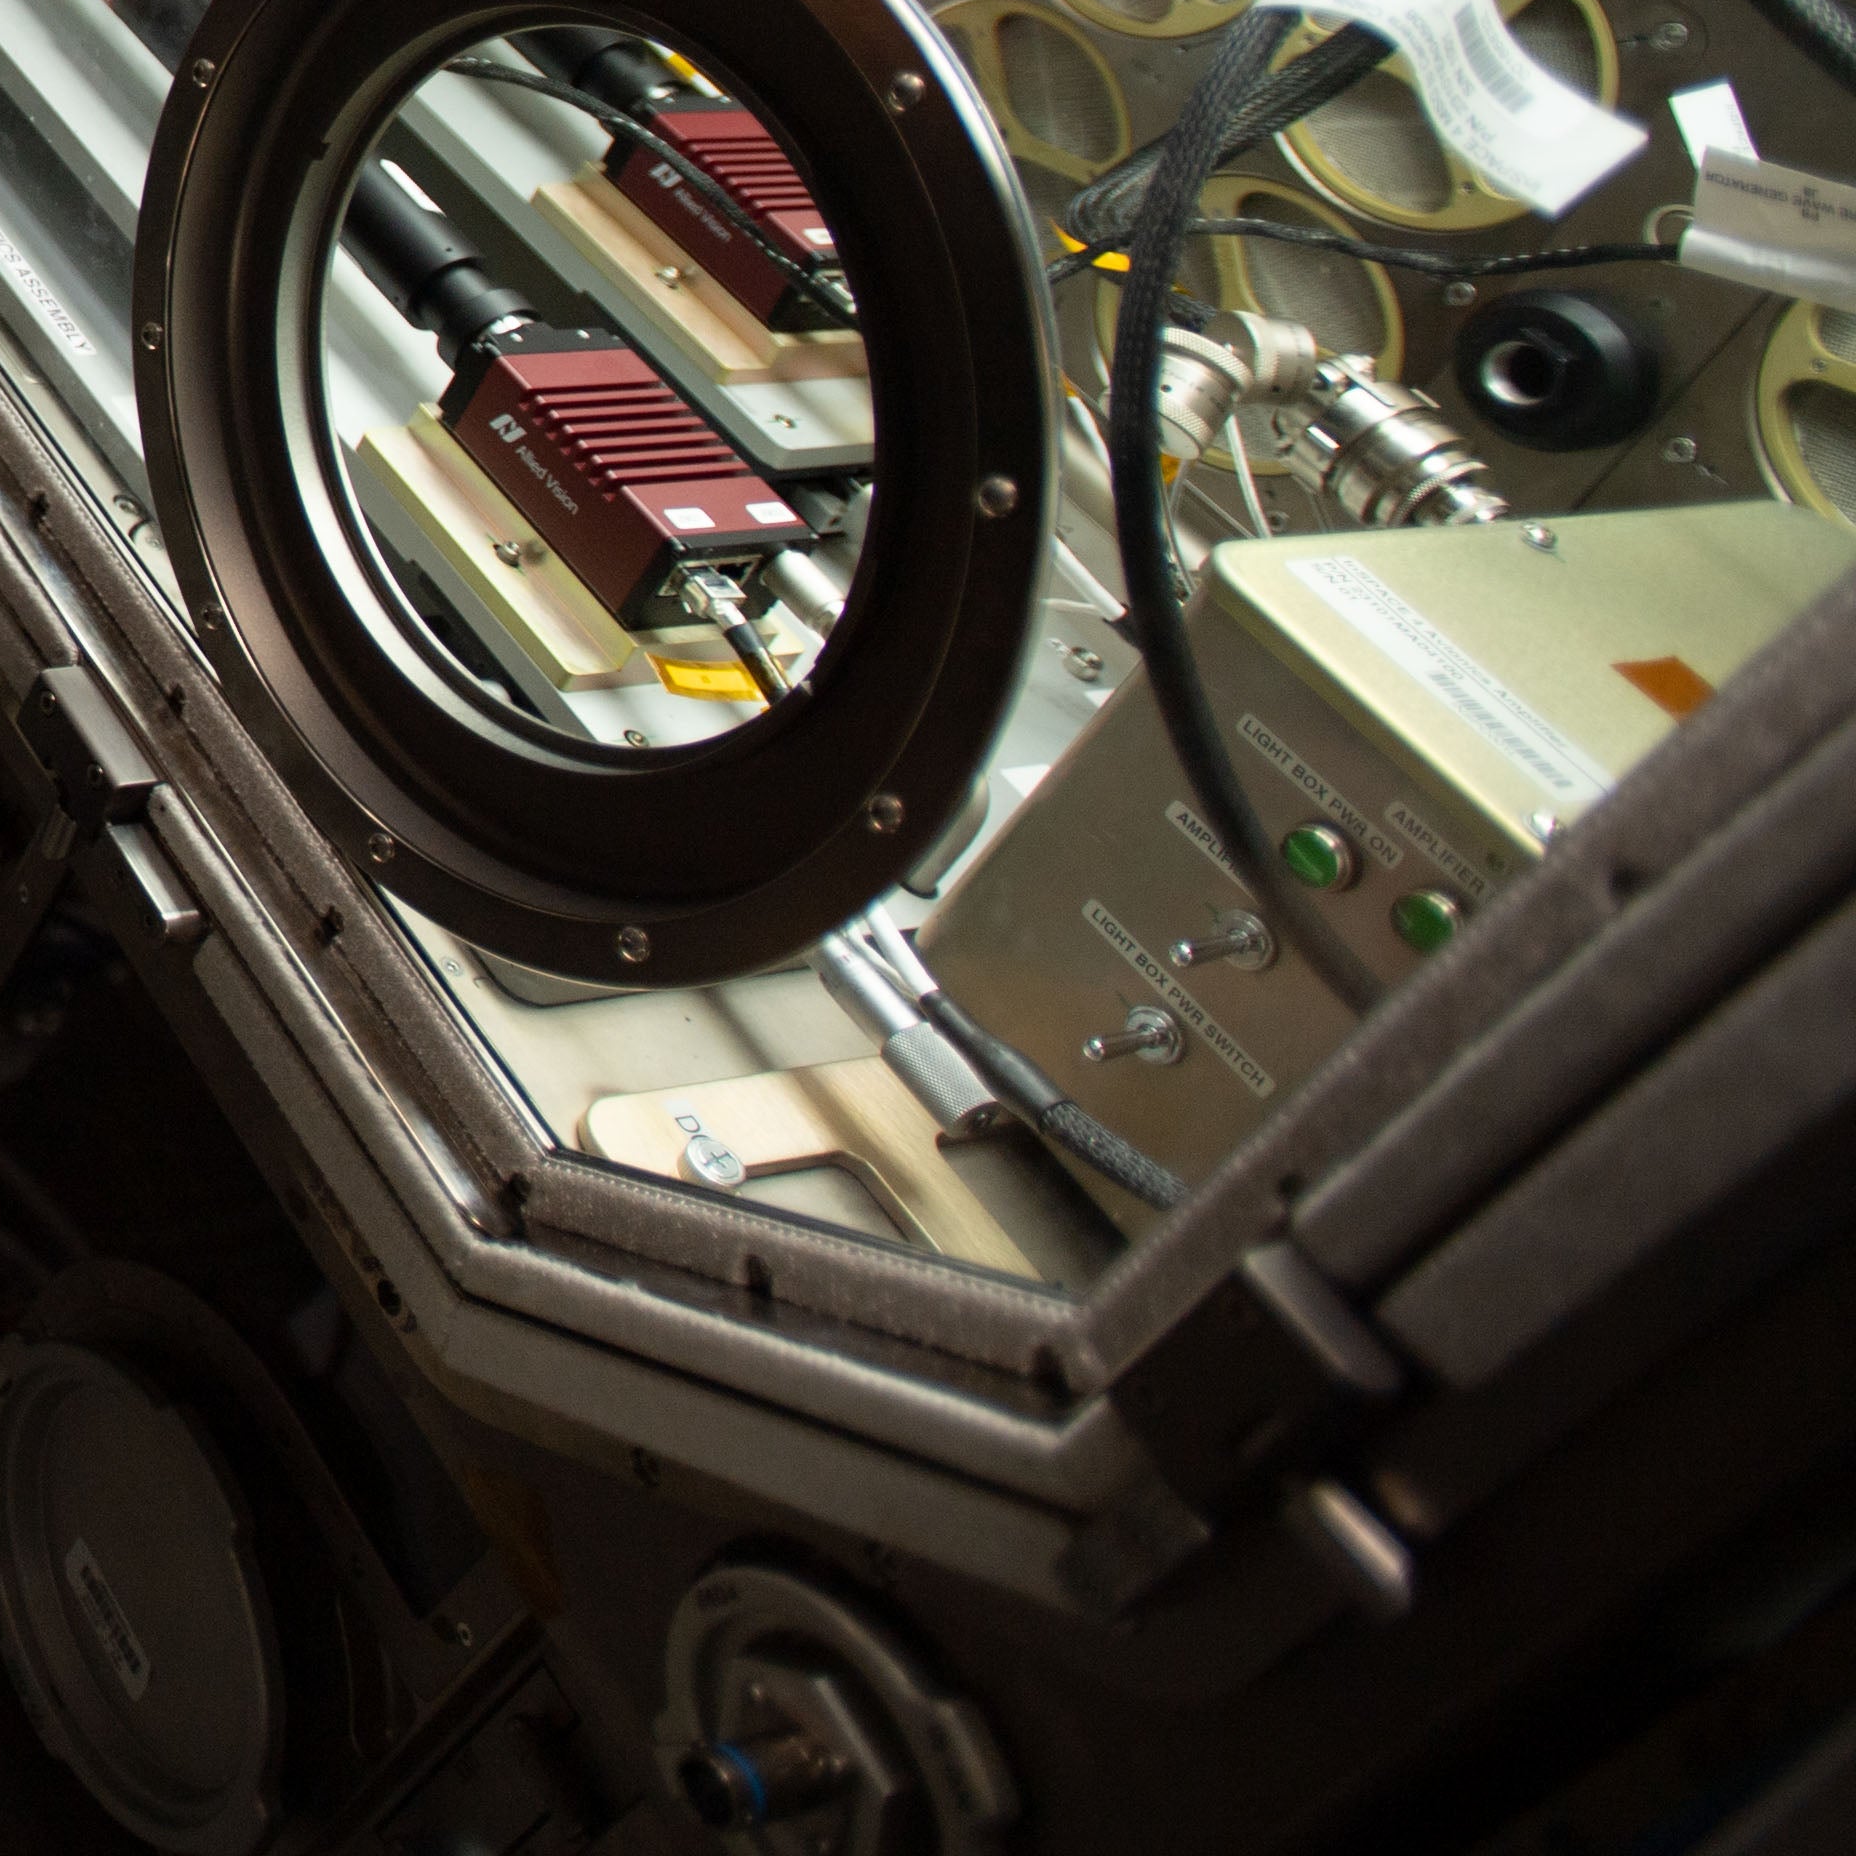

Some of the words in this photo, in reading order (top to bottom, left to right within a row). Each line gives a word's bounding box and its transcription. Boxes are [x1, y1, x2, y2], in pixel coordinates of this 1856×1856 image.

[698, 209, 732, 246] Vision
[1703, 173, 1789, 203] GENERATOR
[1791, 194, 1835, 216] WAVE
[14, 263, 91, 357] ASSEMBLY
[514, 443, 549, 482] Allied
[542, 473, 581, 518] Vision
[1341, 557, 1413, 618] InSPACE
[1420, 624, 1495, 688] Avionics
[1494, 686, 1569, 750] Amplifier
[1241, 718, 1293, 767] LIGHT
[1290, 762, 1330, 801] BOX
[1327, 796, 1369, 837] PWR
[1366, 833, 1398, 864] ON
[1391, 806, 1487, 896] AMPLIFIER
[1089, 907, 1136, 955] LIGHT
[1133, 952, 1170, 989] BOX
[1166, 985, 1206, 1026] PWR
[1202, 1022, 1267, 1087] SWITCH
